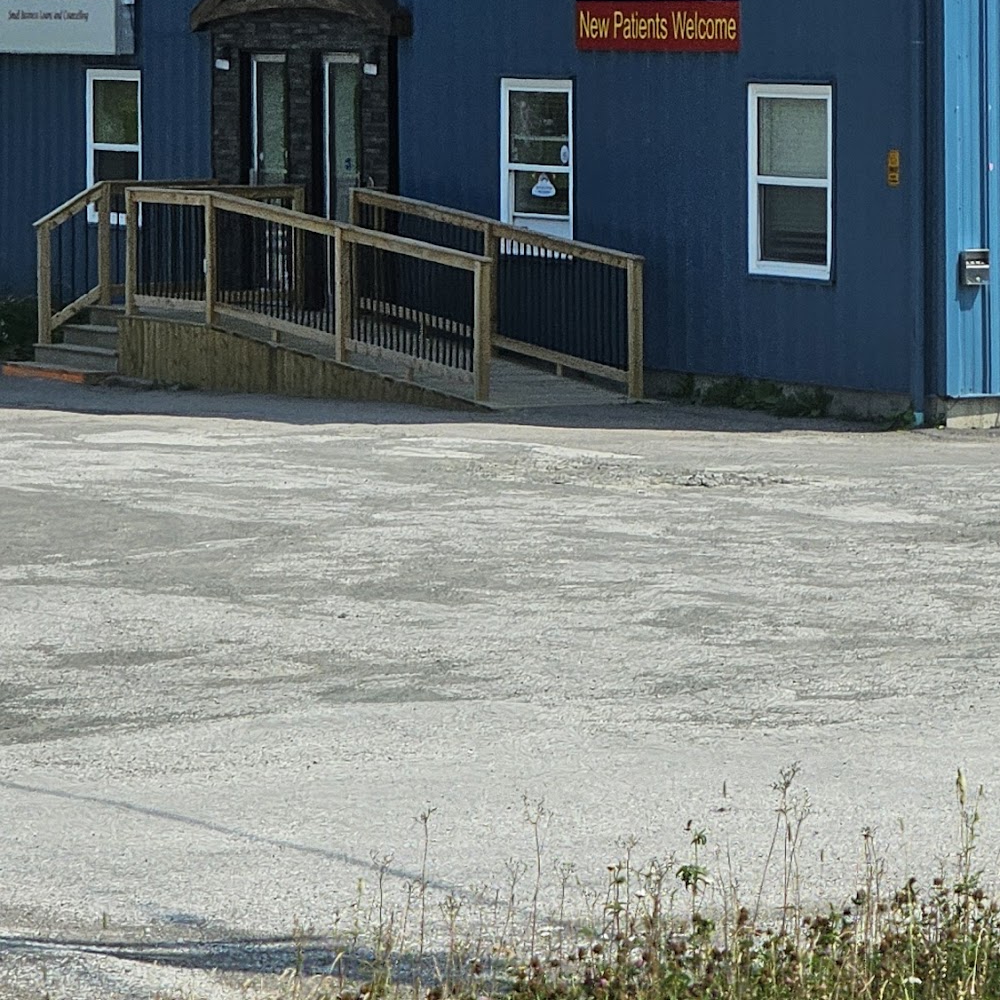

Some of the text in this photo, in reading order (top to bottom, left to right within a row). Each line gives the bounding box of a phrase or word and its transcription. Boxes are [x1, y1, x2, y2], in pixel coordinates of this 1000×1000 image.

[580, 11, 736, 40] New Patients Welcome
